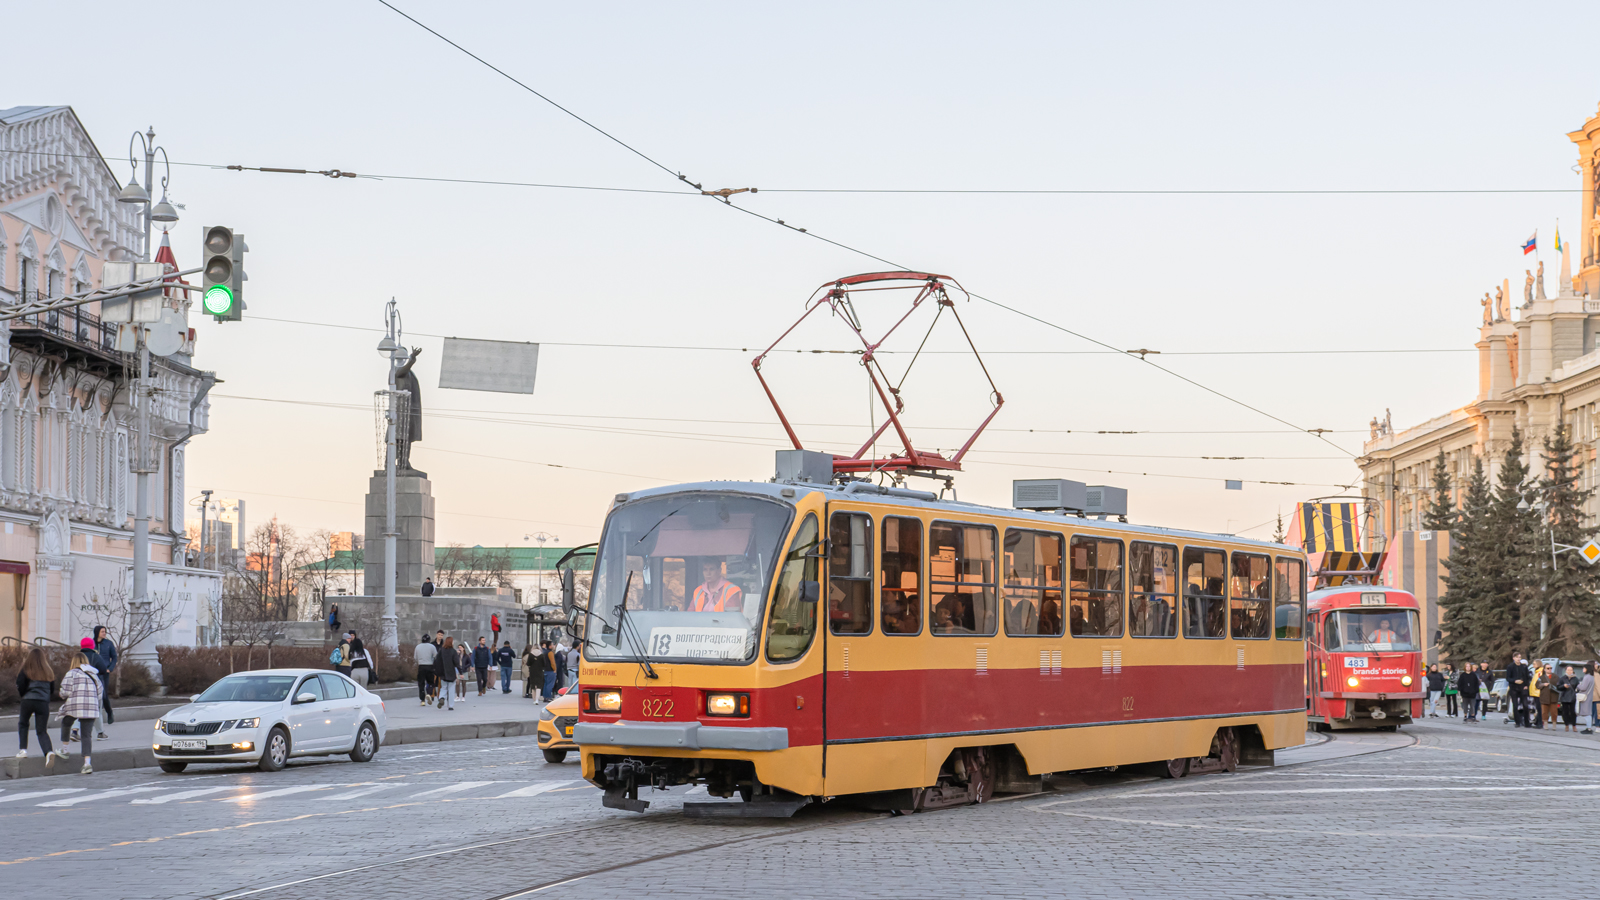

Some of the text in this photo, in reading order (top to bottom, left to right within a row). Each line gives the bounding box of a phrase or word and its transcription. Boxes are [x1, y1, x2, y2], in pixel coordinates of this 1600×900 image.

[177, 592, 192, 601] ROLEX
[1367, 595, 1380, 604] 15
[652, 634, 672, 656] 18
[1348, 659, 1364, 667] 483
[642, 698, 675, 718] 822
[1122, 696, 1134, 711] 822
